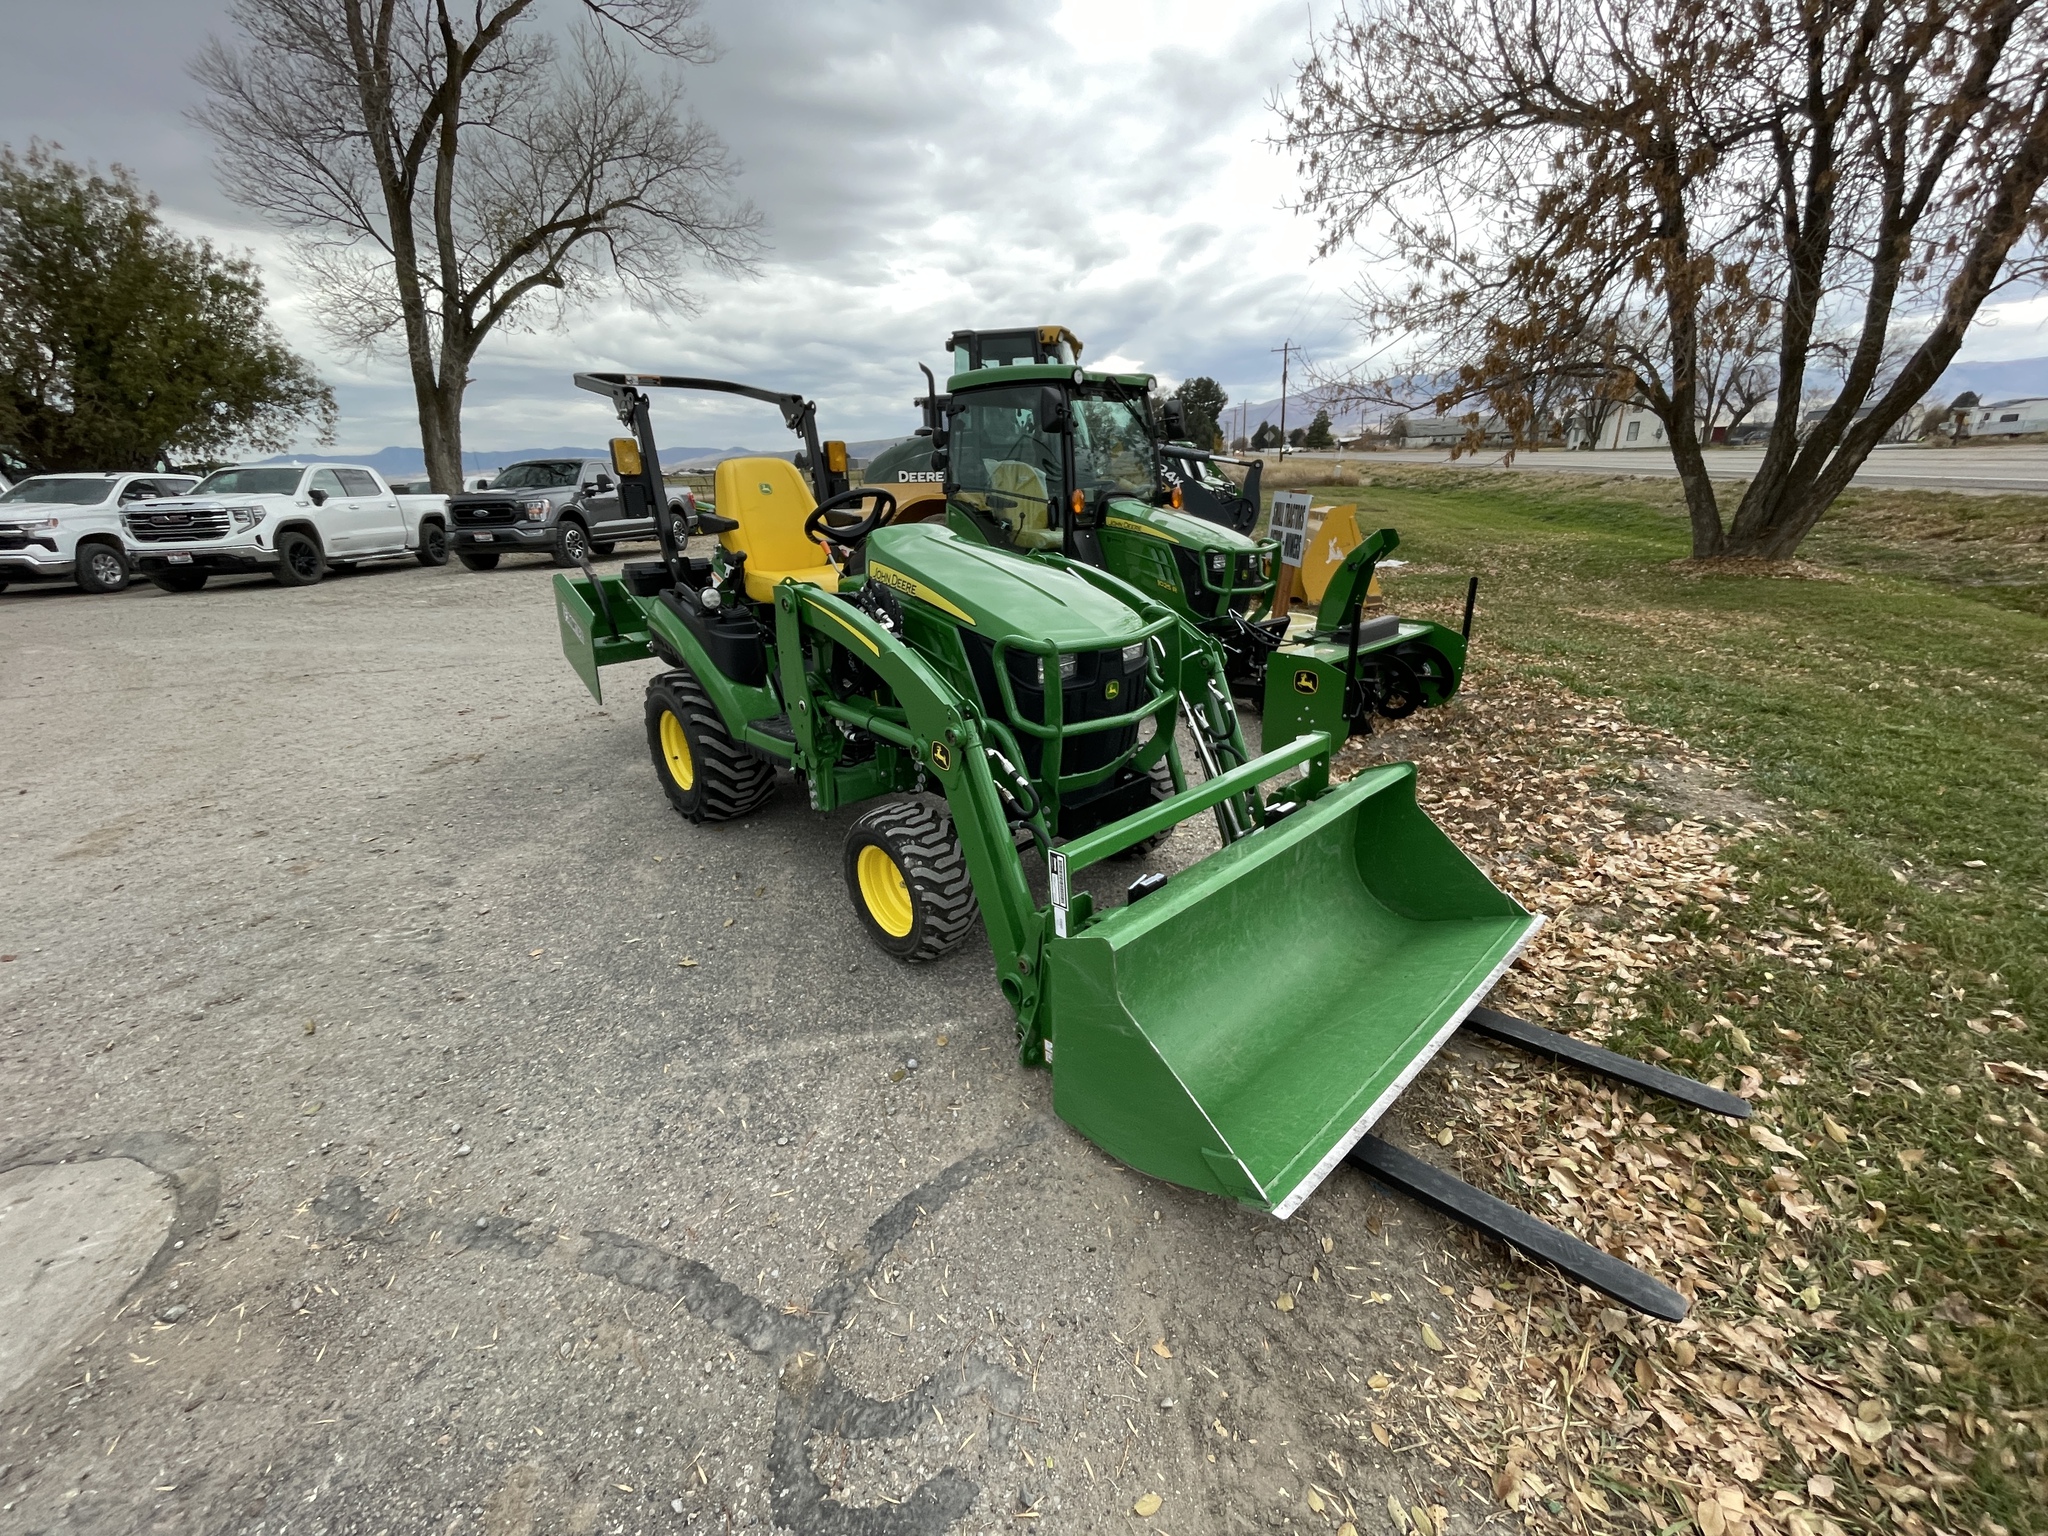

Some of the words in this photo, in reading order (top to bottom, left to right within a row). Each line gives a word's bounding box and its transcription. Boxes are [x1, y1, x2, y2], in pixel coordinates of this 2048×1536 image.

[898, 470, 945, 483] DEERE
[873, 567, 892, 584] JOHN
[892, 573, 917, 595] DEERE
